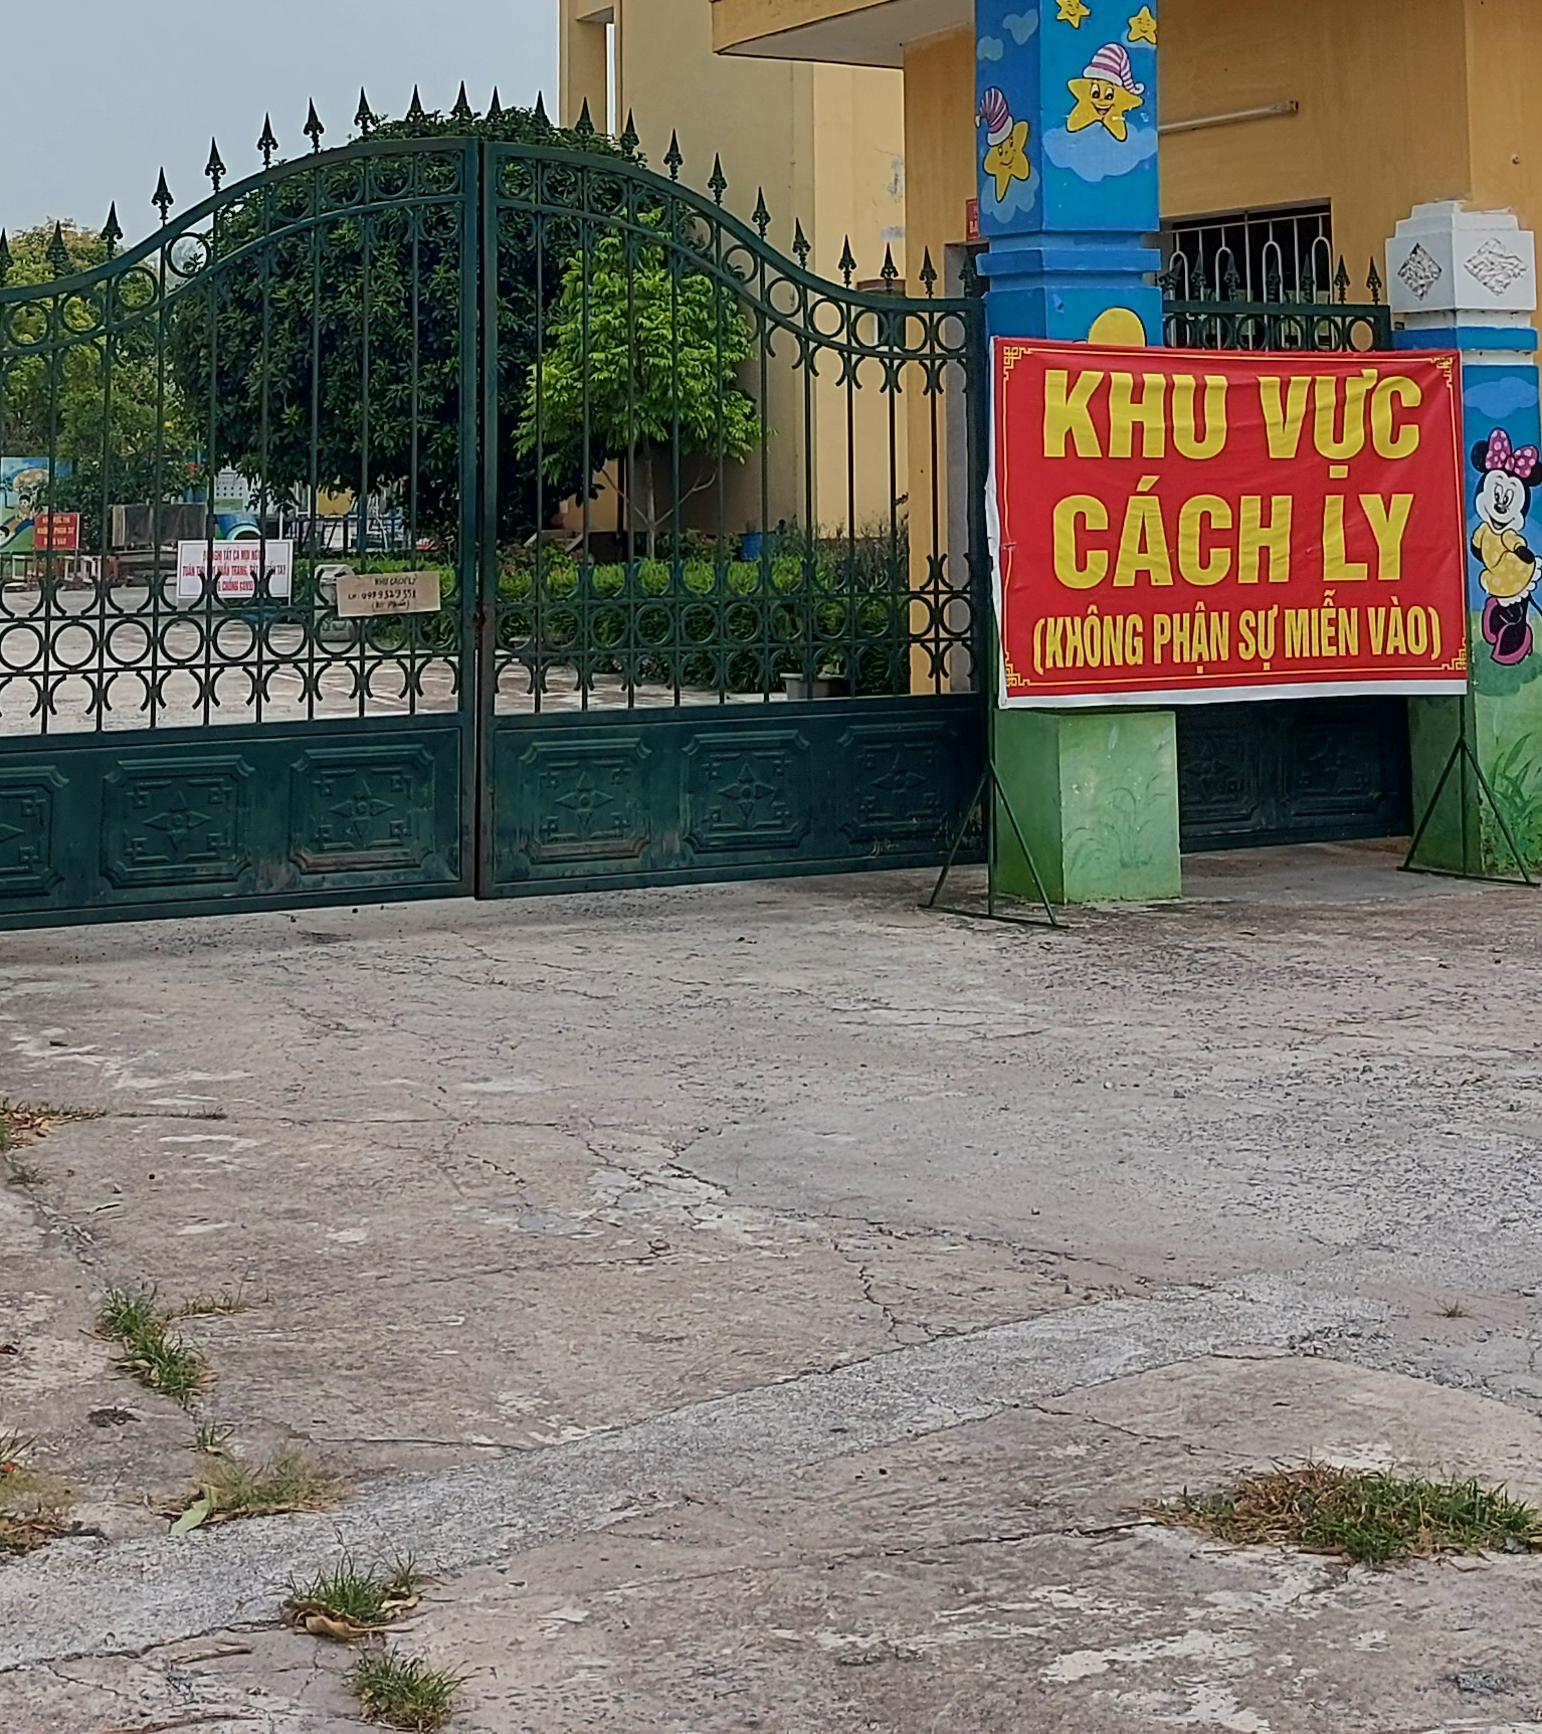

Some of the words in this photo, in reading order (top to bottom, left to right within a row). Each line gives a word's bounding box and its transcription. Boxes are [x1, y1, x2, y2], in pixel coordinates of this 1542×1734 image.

[1042, 369, 1229, 460] KHU
[1258, 368, 1423, 479] VỰC
[1052, 475, 1293, 590] CÁCH
[1322, 494, 1415, 582] LY
[1033, 604, 1144, 676] (KHÔNG
[1153, 601, 1230, 675] PHẬN
[1238, 604, 1279, 671] SỰ
[1284, 589, 1358, 659] MIỄN
[1367, 597, 1442, 661] VÀO)
